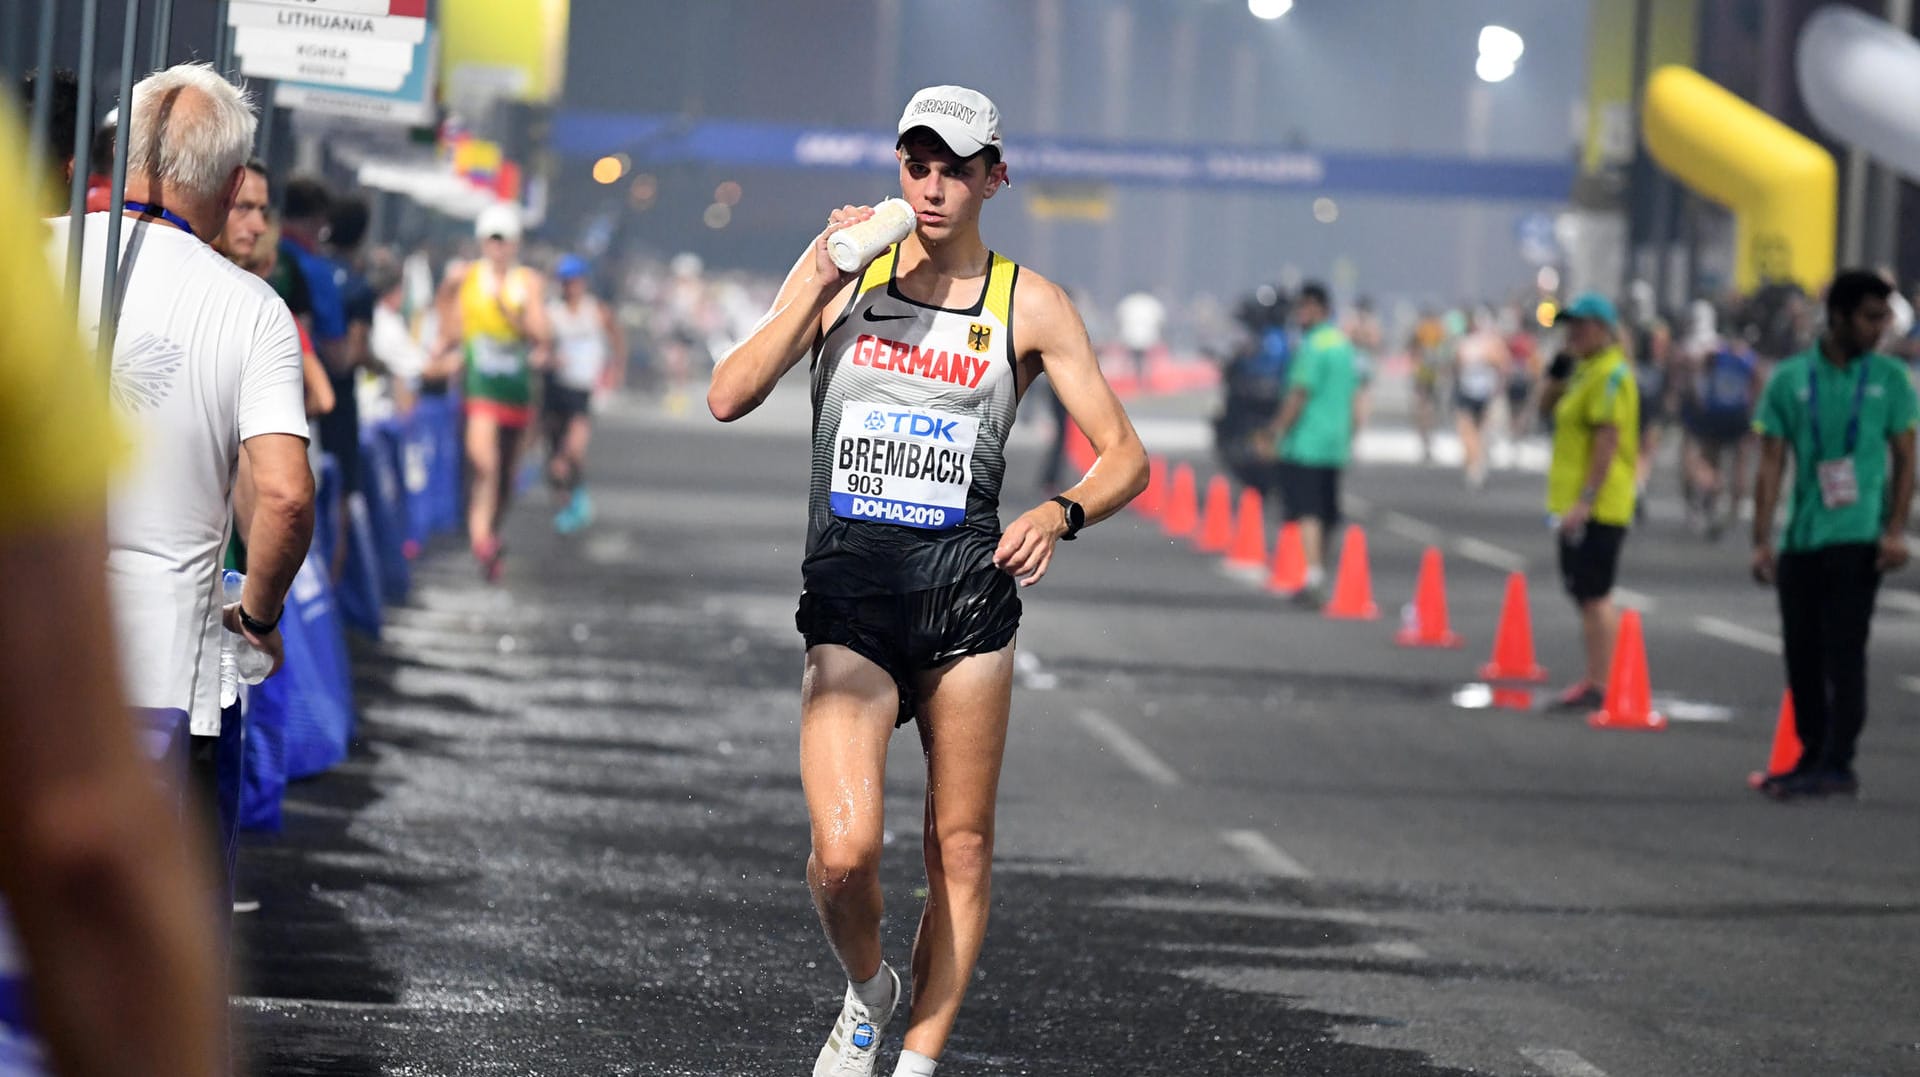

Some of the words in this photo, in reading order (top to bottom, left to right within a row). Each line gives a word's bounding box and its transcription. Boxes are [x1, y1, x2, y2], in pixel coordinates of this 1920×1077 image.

[276, 10, 375, 33] LITHUANIA
[852, 333, 990, 389] GERMANY
[887, 412, 960, 443] TDK
[838, 437, 965, 485] BREMBACH
[847, 473, 884, 496] 903
[851, 498, 946, 527] DOHA2019
